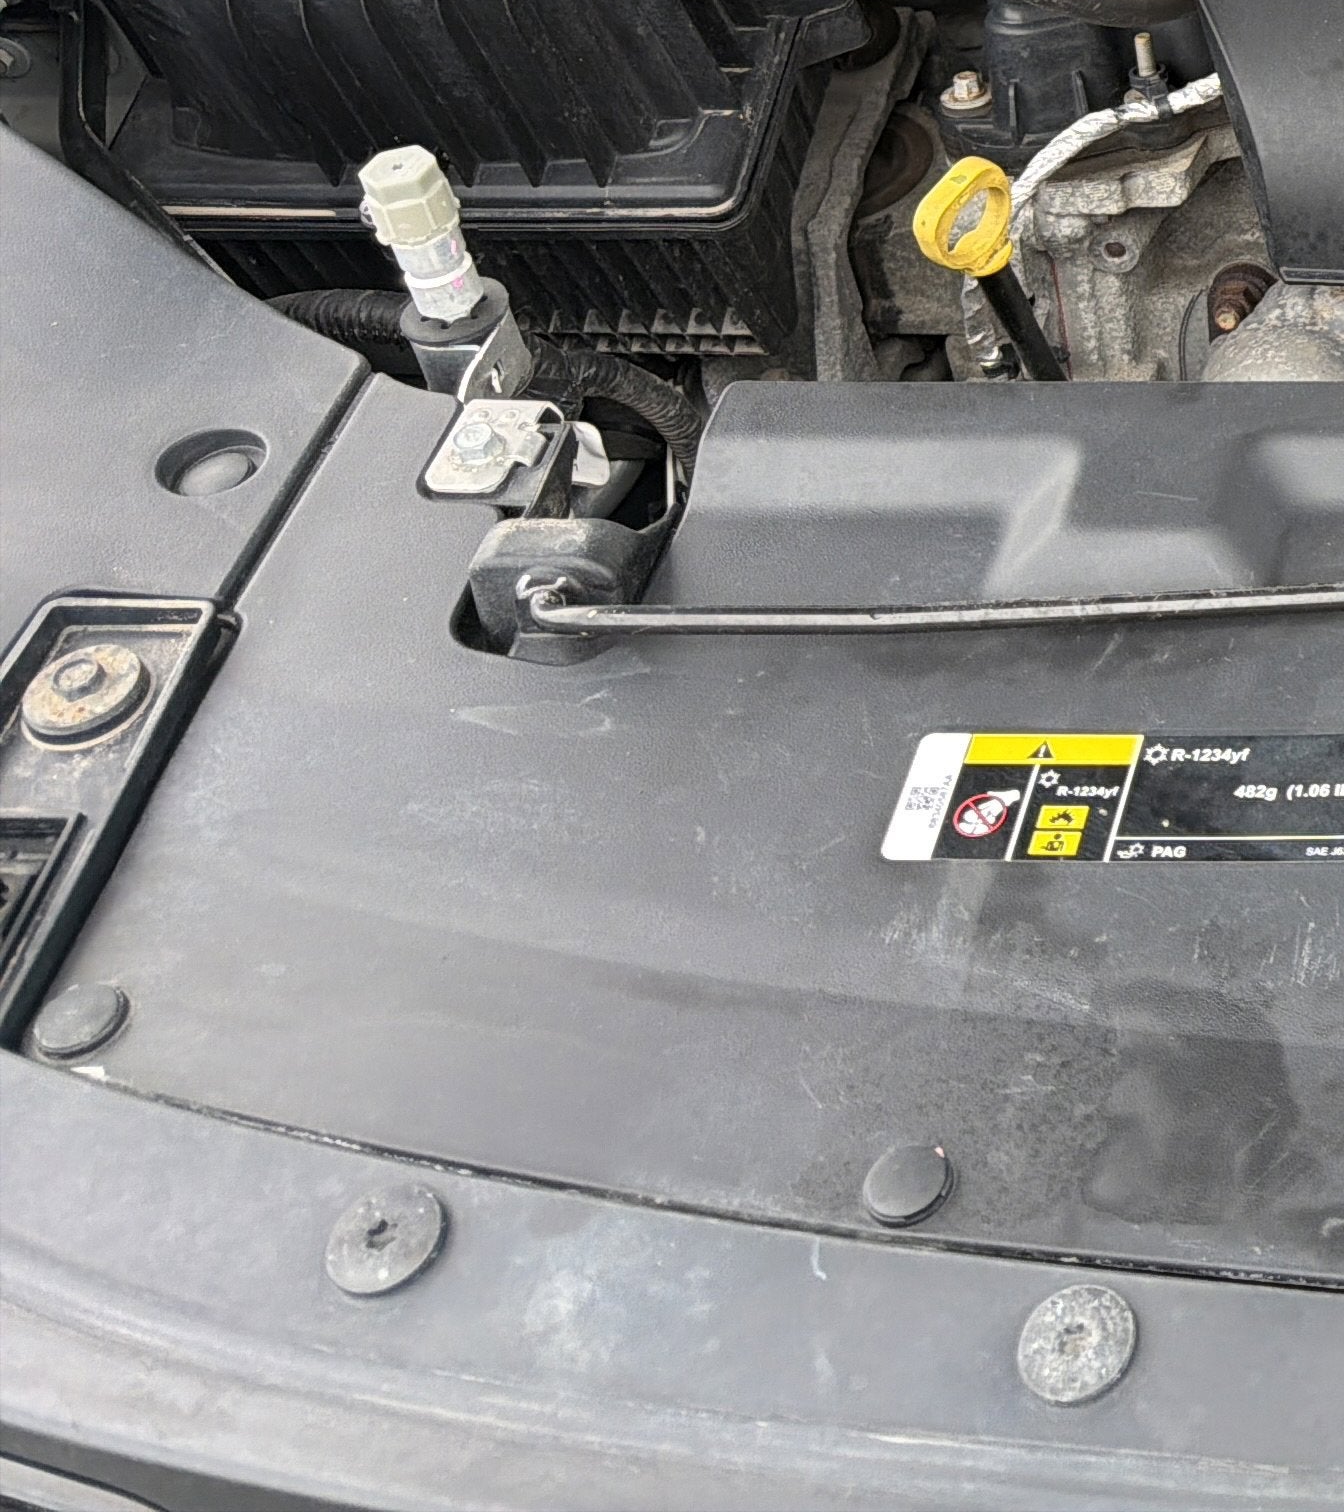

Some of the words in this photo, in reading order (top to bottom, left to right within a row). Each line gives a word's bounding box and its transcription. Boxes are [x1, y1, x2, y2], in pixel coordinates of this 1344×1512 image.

[1169, 746, 1250, 765] R-1234yf
[1055, 785, 1120, 799] R-1234yf
[1233, 785, 1278, 801] 482g
[1286, 783, 1330, 800] (1.06
[1151, 845, 1187, 858] PAG
[1305, 846, 1329, 857] SAE
